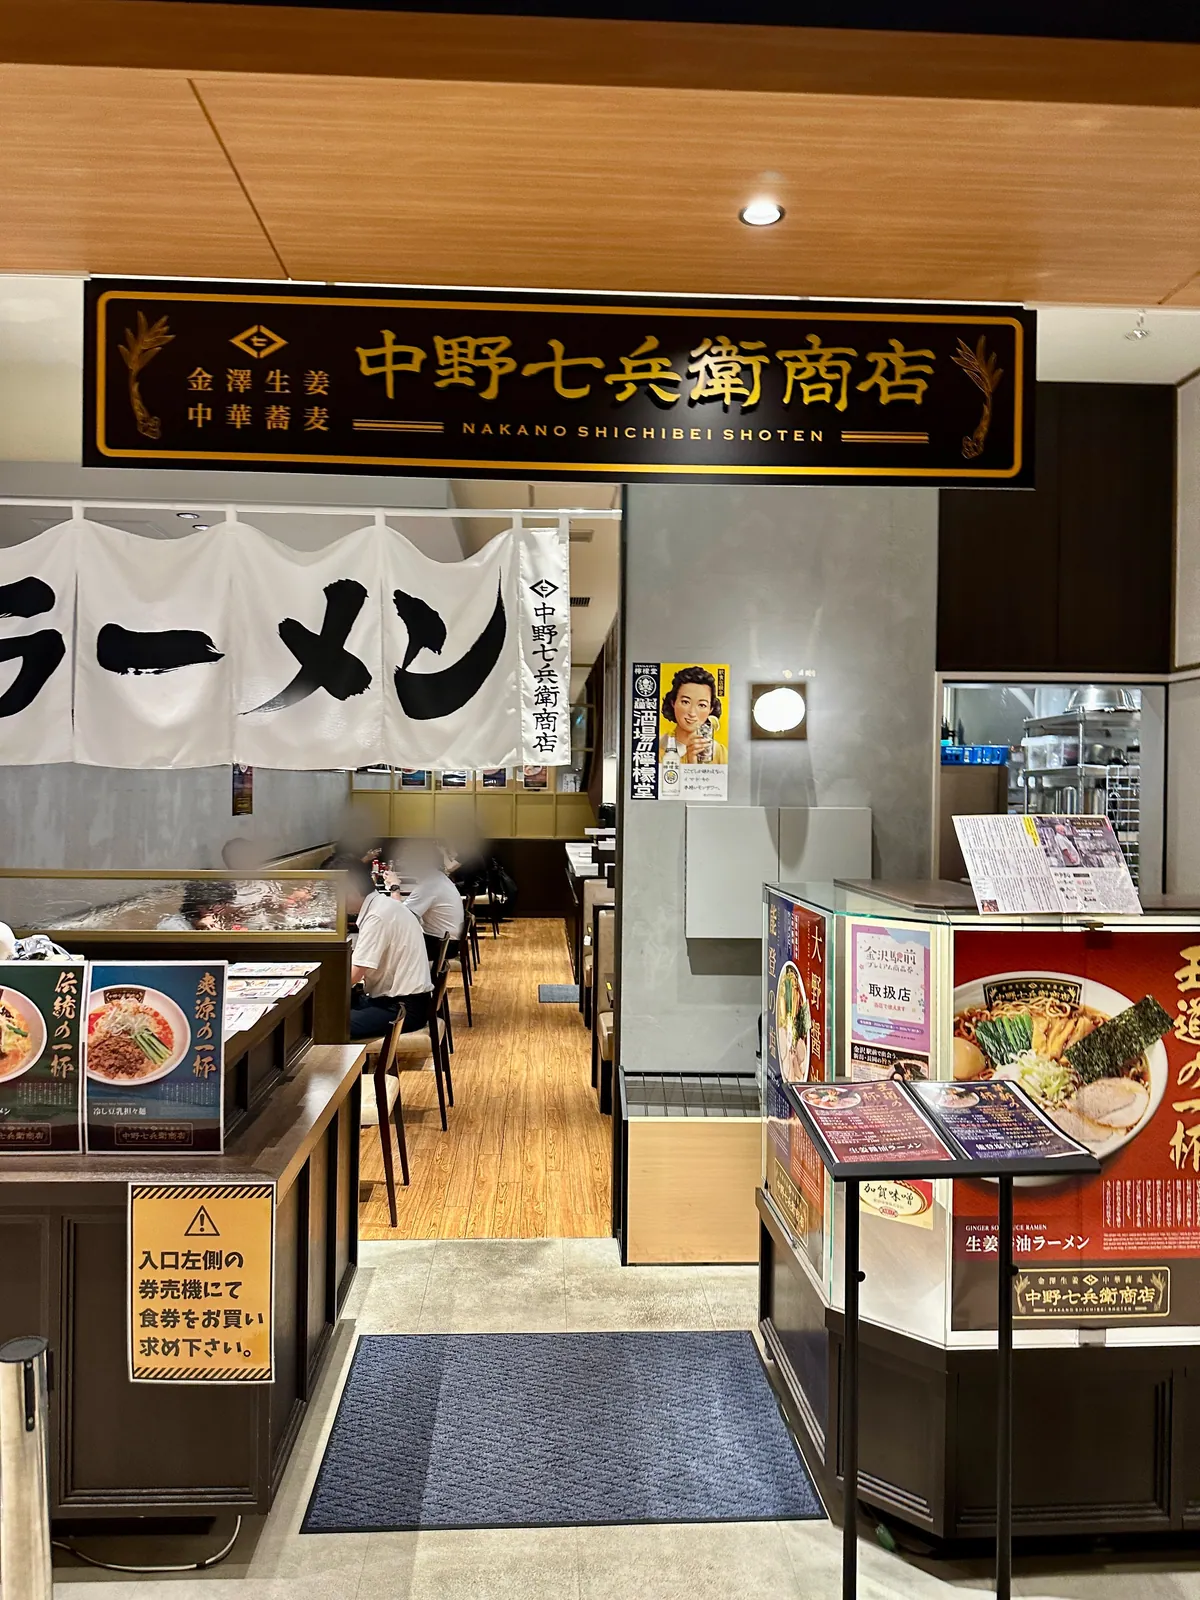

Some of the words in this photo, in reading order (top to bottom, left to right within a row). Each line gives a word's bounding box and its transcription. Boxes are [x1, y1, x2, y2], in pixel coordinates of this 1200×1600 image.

[355, 330, 937, 411] 中野七兵衛商店
[186, 367, 331, 397] 金澤生姜
[186, 403, 331, 432] 中華蕎麦
[463, 422, 567, 438] NAKANO
[578, 424, 712, 440] SHICHIBEI
[722, 428, 824, 442] SHOTEN
[0, 565, 506, 721] ラーメン
[532, 602, 560, 753] 中野七兵衛商店
[632, 710, 657, 799] 酒場の檸檬堂
[868, 983, 911, 1002] 取扱店
[50, 971, 78, 1079] 伝統の一杯
[193, 972, 217, 1079] 爽涼の一杯
[864, 1183, 914, 1206] 加賀味噌
[966, 1224, 990, 1232] GINGER
[1025, 1223, 1048, 1232] RAMEN
[966, 1234, 1090, 1253] 生姜油ラーメン
[139, 1250, 244, 1270] 入口左側の
[139, 1279, 243, 1299] 券売機にて
[1025, 1286, 1156, 1307] 中野七兵衛商店
[139, 1308, 264, 1329] 食券をお買い
[139, 1337, 251, 1358] 求め下さい。
